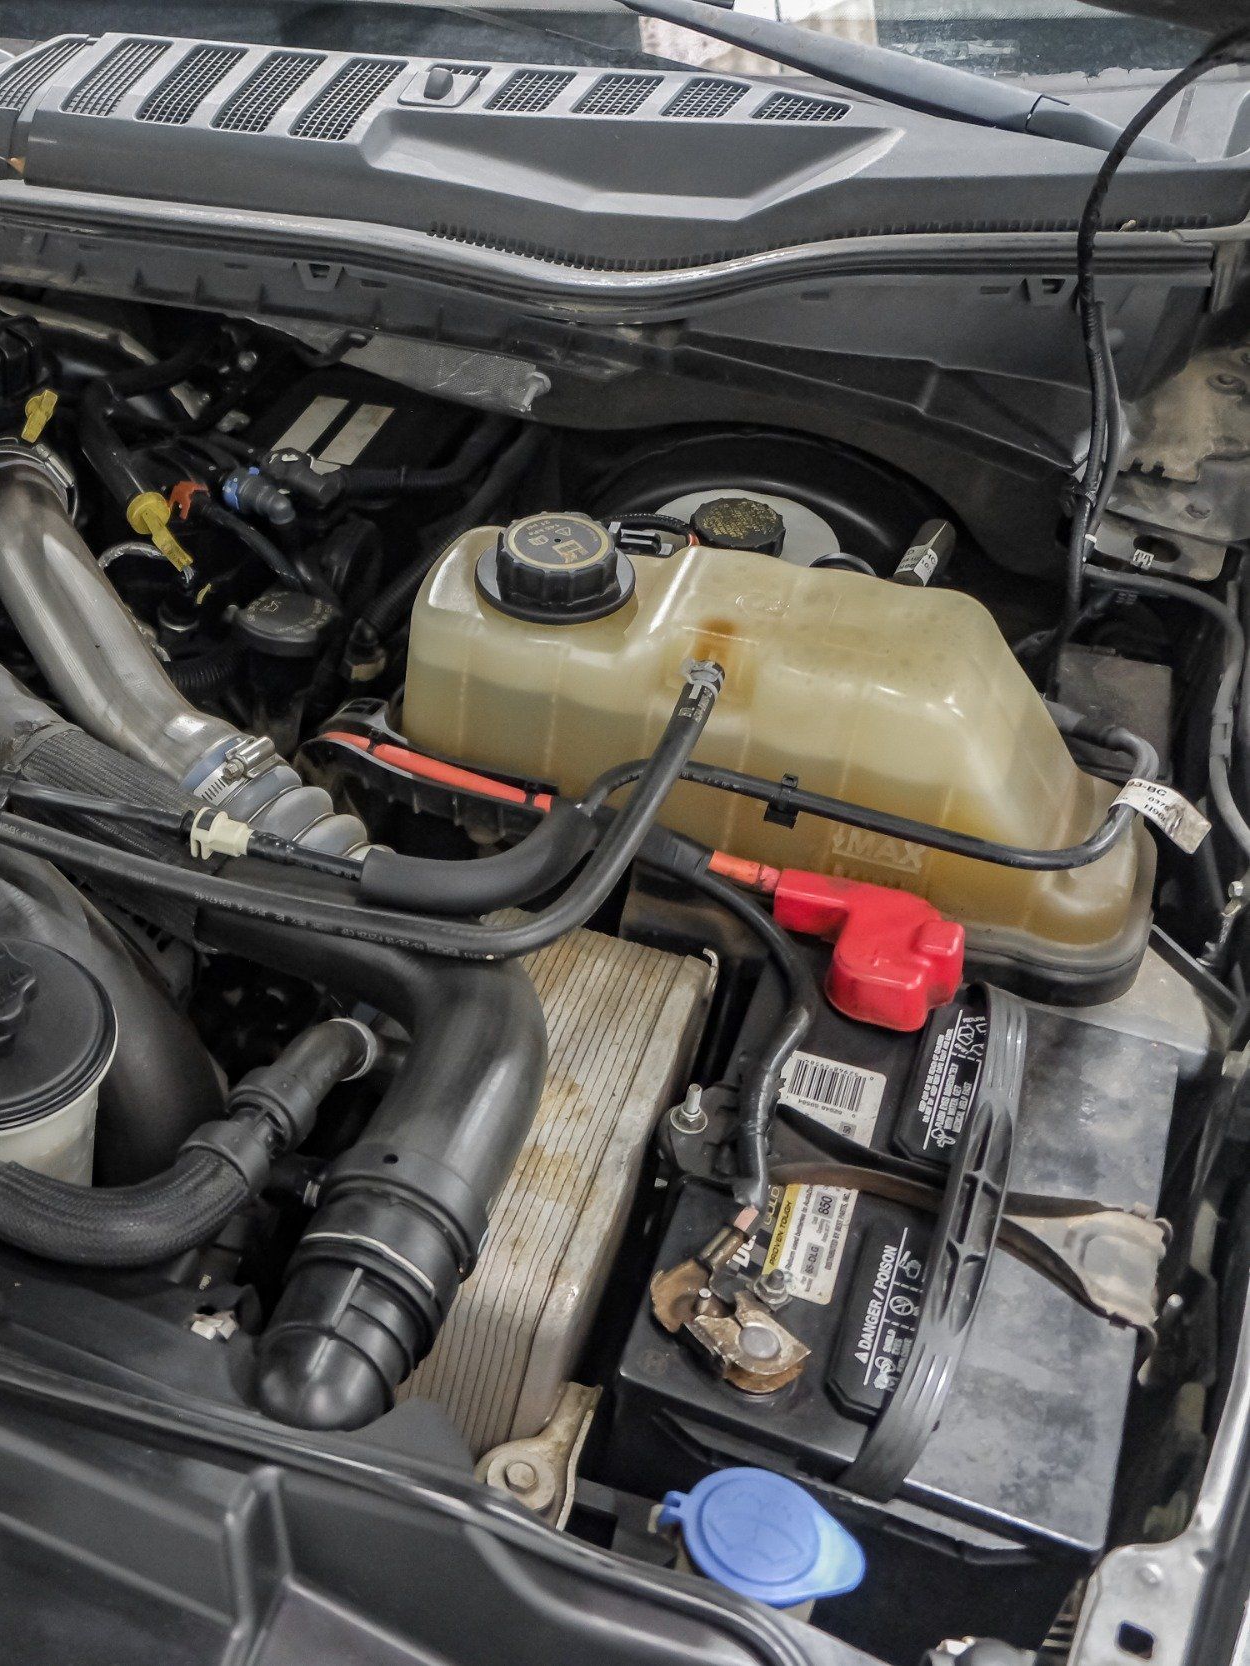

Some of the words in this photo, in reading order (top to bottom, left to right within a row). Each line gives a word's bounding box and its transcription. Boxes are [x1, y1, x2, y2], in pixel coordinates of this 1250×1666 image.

[846, 828, 928, 869] MAX
[770, 1231, 784, 1266] PROVEN
[779, 1202, 793, 1228] TOUGH
[858, 1298, 883, 1350] DANGER
[874, 1244, 898, 1290] POISON
